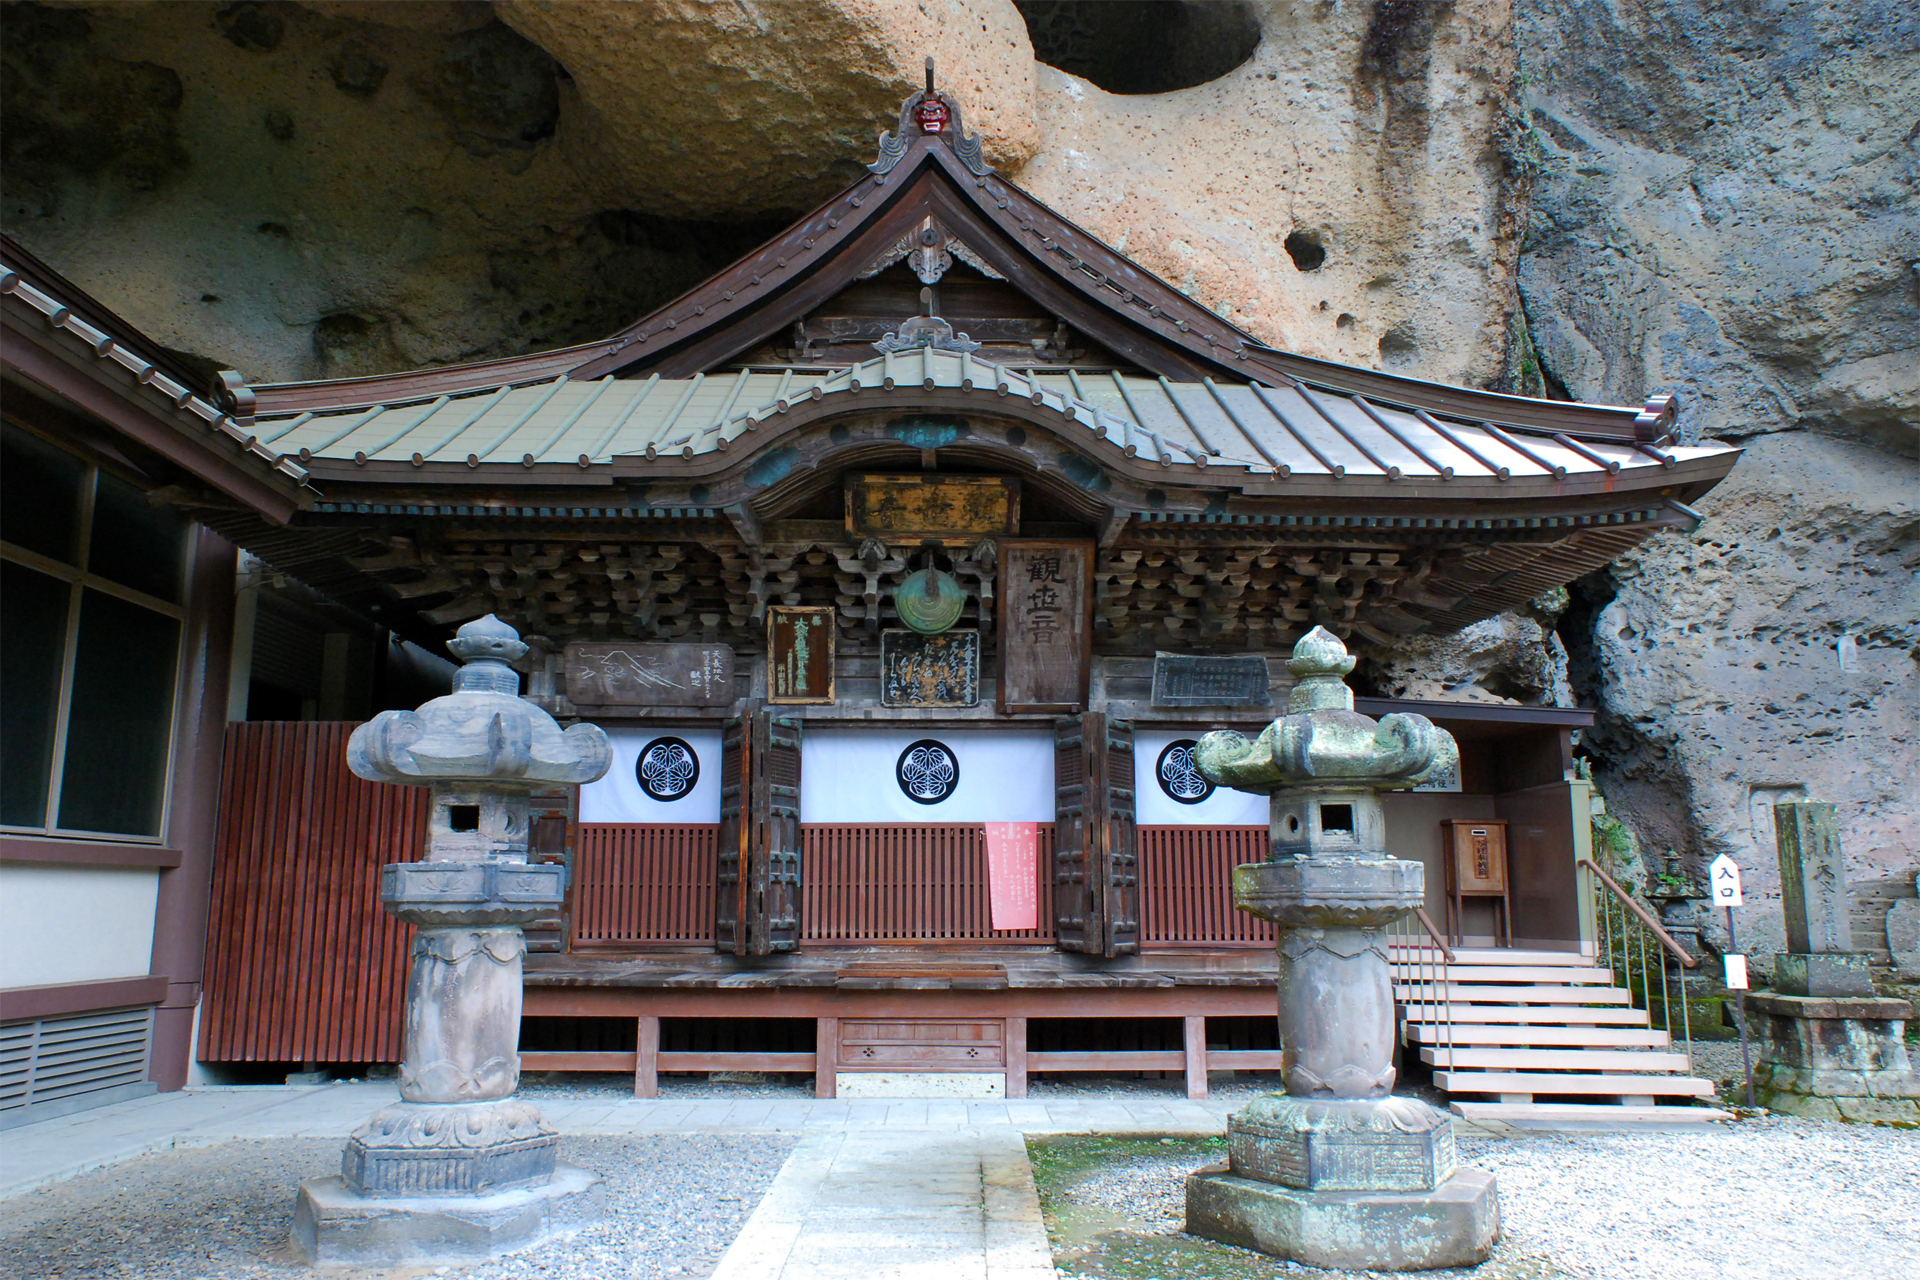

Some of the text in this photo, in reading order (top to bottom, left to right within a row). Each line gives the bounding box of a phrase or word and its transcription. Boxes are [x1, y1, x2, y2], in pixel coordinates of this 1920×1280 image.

[712, 650, 726, 683] 天長地久
[1718, 867, 1735, 898] 入口
